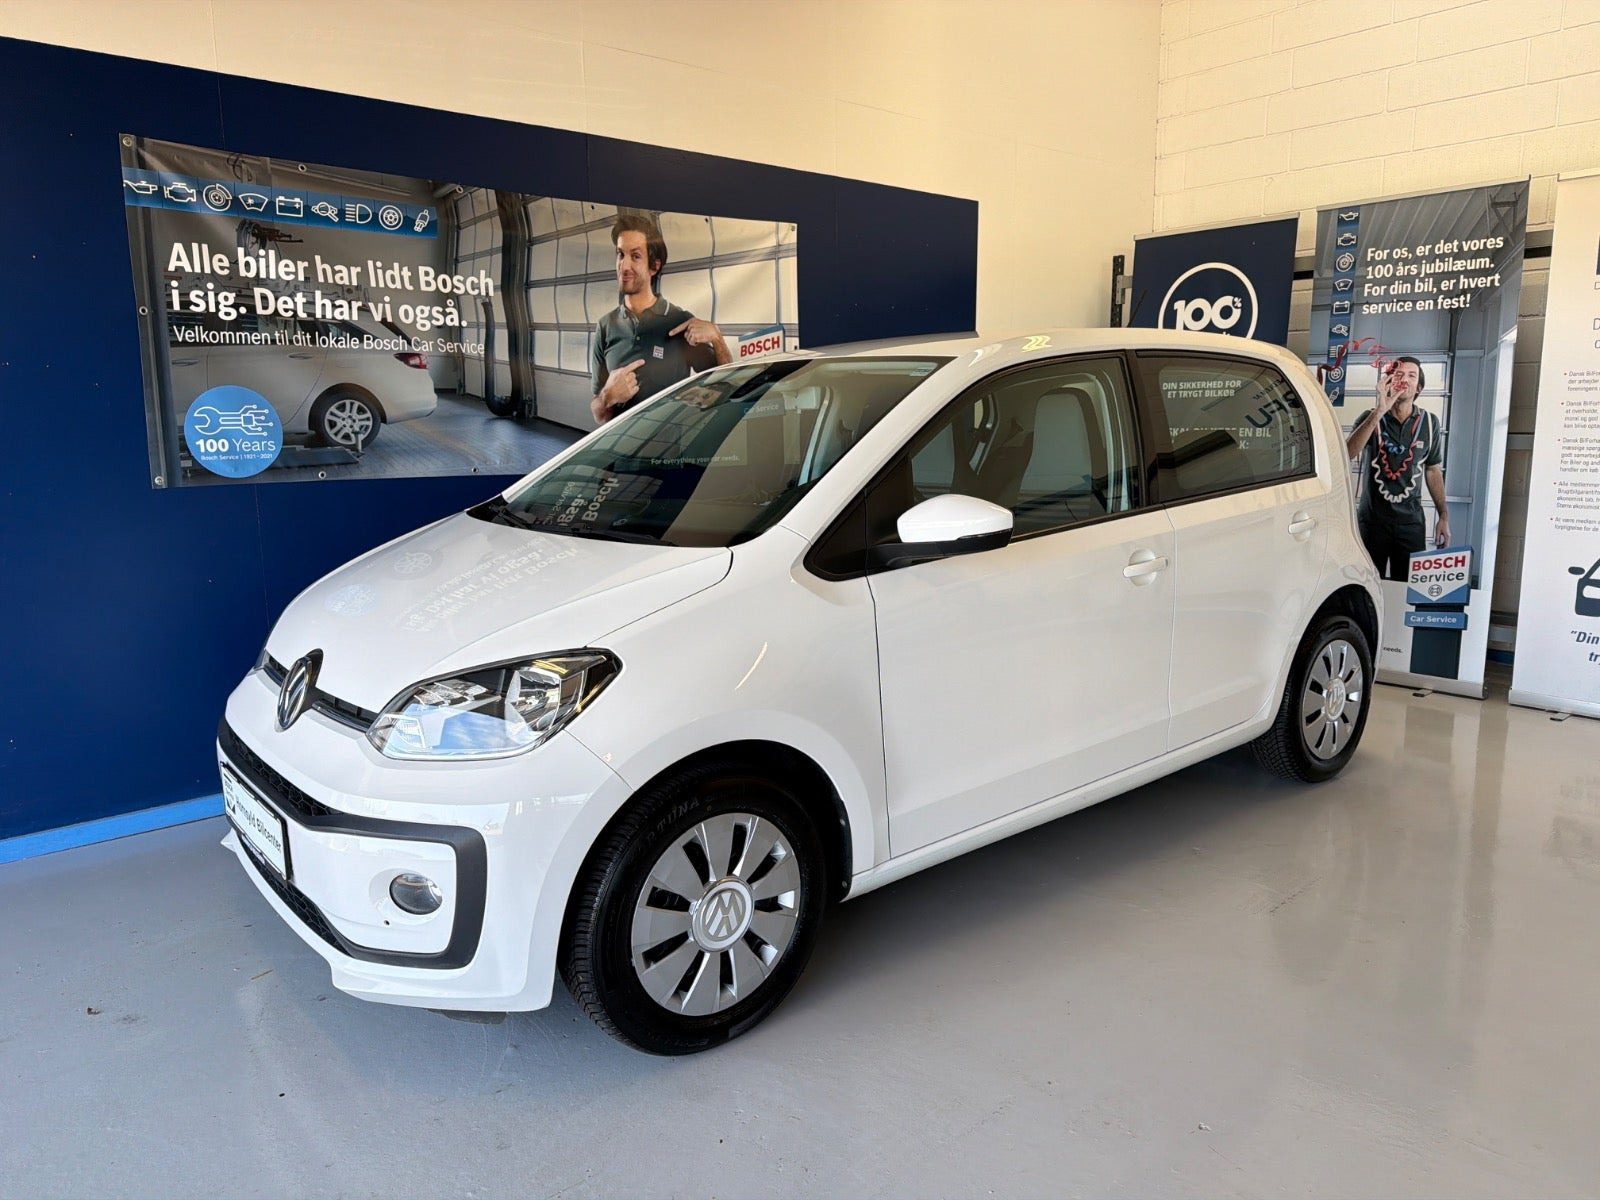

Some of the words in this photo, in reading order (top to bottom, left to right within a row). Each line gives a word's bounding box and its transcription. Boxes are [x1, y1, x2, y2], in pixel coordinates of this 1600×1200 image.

[1367, 248, 1390, 261] For
[1393, 247, 1412, 259] os,
[1416, 244, 1432, 256] er
[1435, 240, 1458, 254] det
[1462, 237, 1504, 251] vores
[168, 242, 230, 275] Alle
[238, 246, 308, 281] biler
[316, 254, 361, 286] har
[368, 260, 412, 290] lidt
[419, 265, 494, 297] Bosch
[1366, 264, 1393, 279] 100
[1396, 262, 1418, 276] års
[1420, 257, 1494, 278] jubilæum.
[1364, 284, 1386, 296] For
[1390, 280, 1410, 294] din
[1415, 278, 1437, 294] bil,
[1440, 279, 1456, 290] er
[1460, 273, 1500, 290] hvert
[171, 281, 179, 311] i
[189, 284, 247, 320] sig.
[254, 287, 306, 318] Det
[315, 290, 362, 322] har
[369, 296, 392, 322] vi
[399, 300, 468, 331] også.
[1362, 299, 1412, 314] service
[1416, 299, 1434, 311] en
[1438, 294, 1471, 310] fest!
[174, 325, 270, 344] Velkommen
[274, 328, 290, 346] til
[292, 330, 312, 348] dit
[316, 332, 359, 350] lokale
[364, 333, 408, 351] Bosch
[412, 337, 434, 352] Car
[438, 338, 485, 354] Service
[740, 336, 781, 358] BOSCH
[1162, 382, 1177, 390] DIN
[1179, 381, 1224, 390] SIKKERHED
[1225, 380, 1242, 388] FOR
[1168, 390, 1176, 398] ET
[1179, 390, 1202, 398] TRYGT
[1239, 428, 1252, 437] EN
[1255, 428, 1272, 438] BIL
[196, 438, 229, 452] 100
[232, 438, 276, 452] Years
[1412, 556, 1466, 572] BOSCH
[1410, 571, 1465, 584] Service
[1426, 616, 1457, 624] Service
